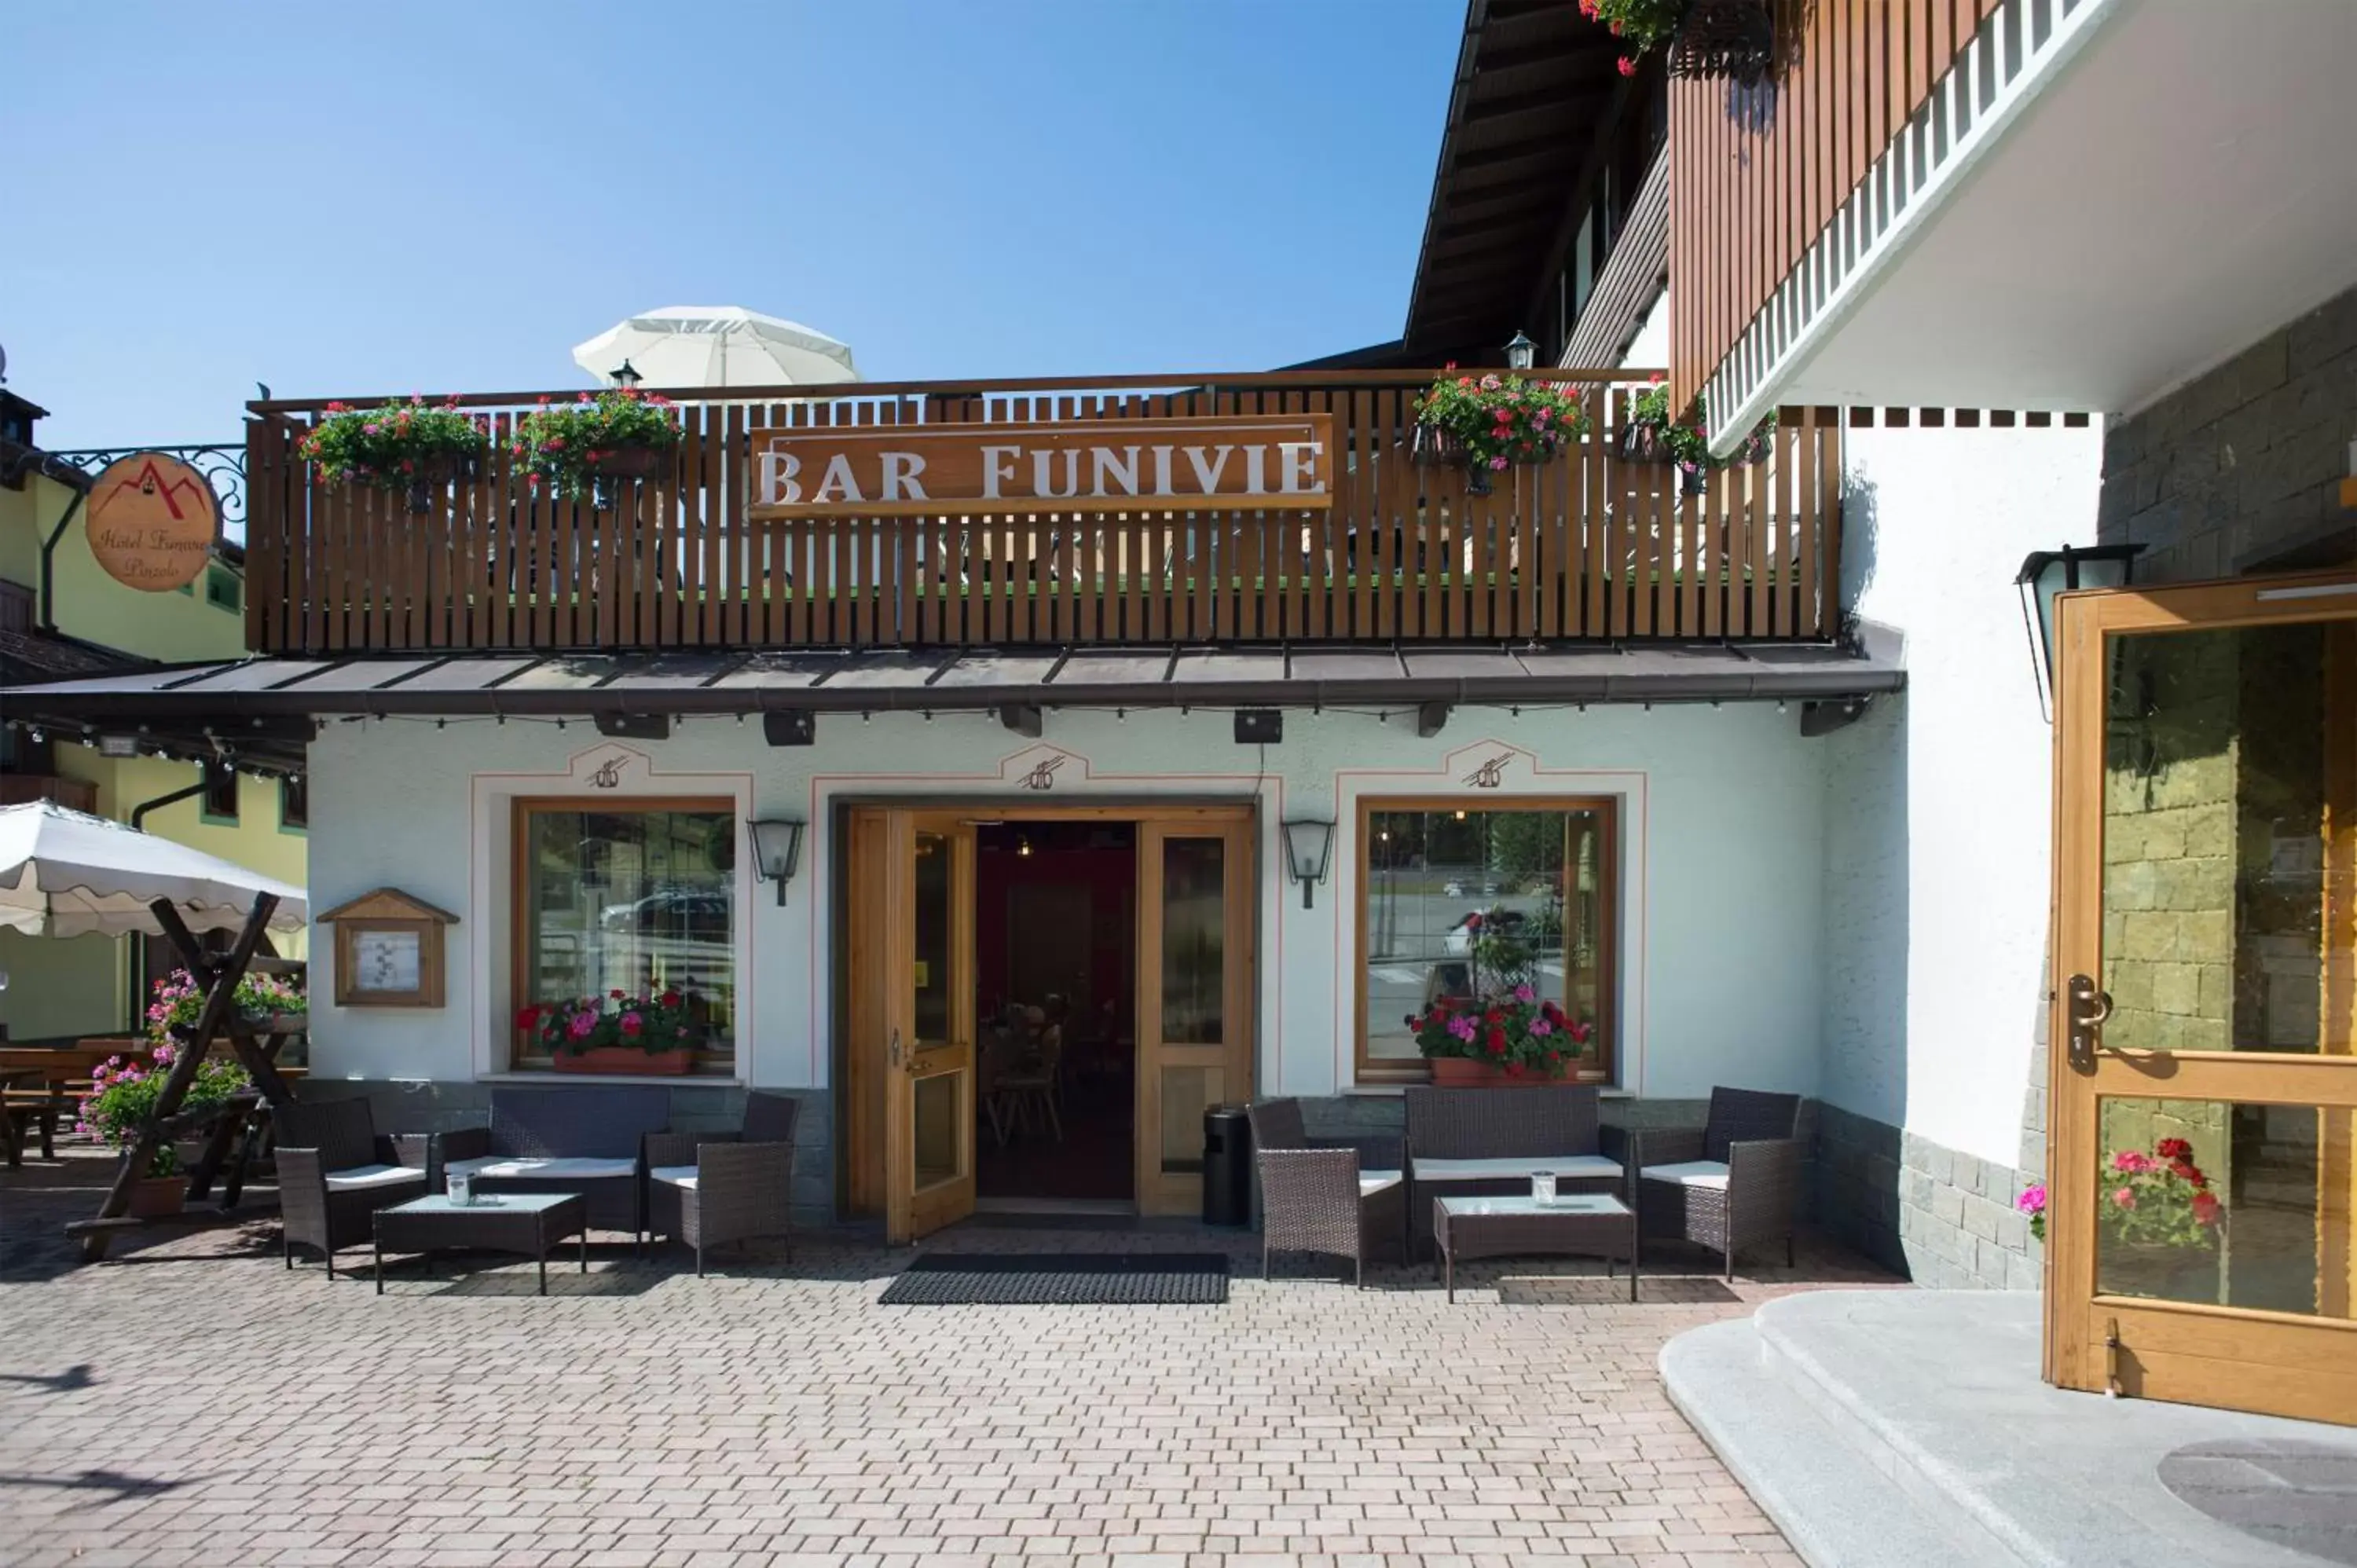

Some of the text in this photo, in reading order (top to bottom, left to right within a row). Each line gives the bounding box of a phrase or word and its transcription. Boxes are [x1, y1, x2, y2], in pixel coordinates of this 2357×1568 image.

[757, 442, 1326, 505] BAR FUNIVIE
[101, 529, 143, 550] Hotel
